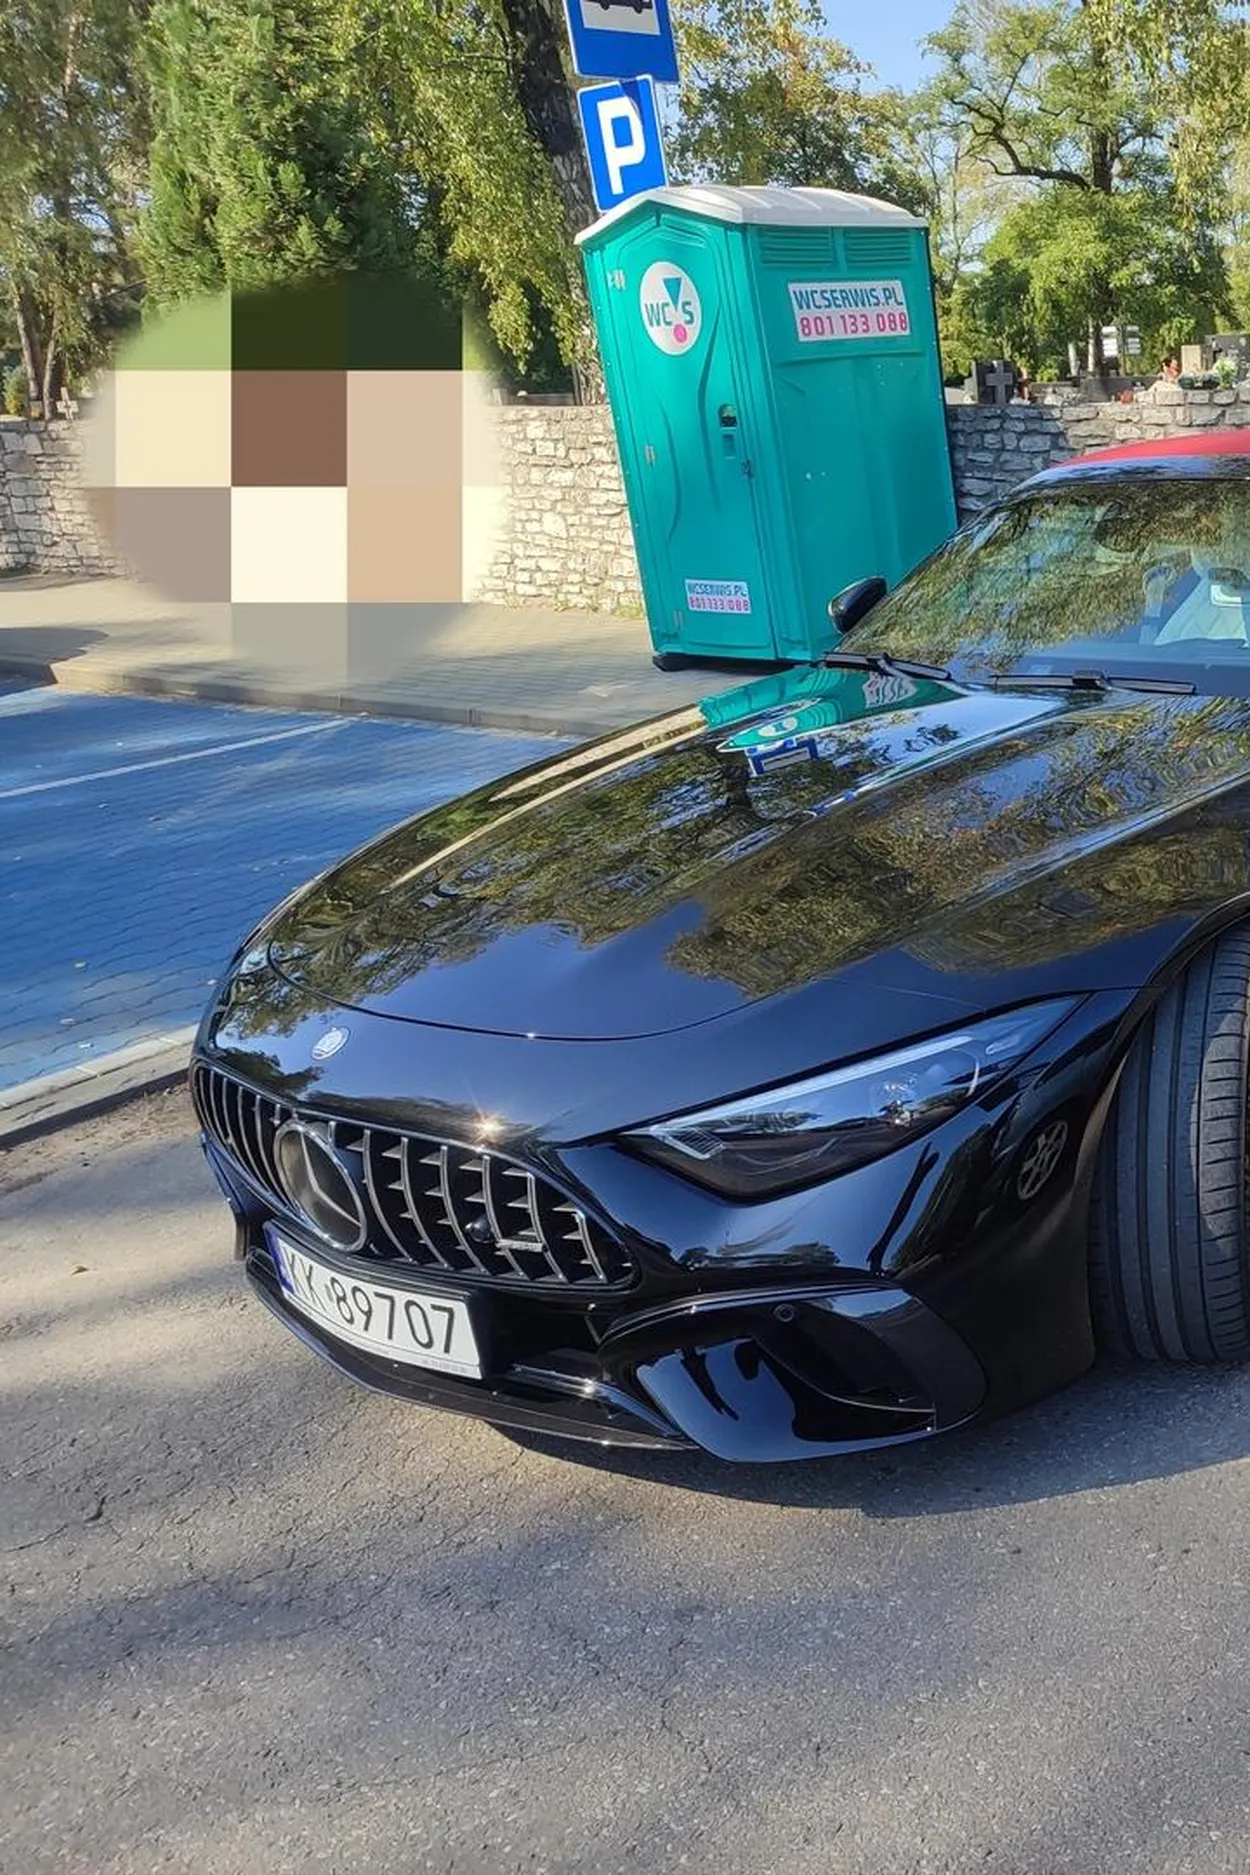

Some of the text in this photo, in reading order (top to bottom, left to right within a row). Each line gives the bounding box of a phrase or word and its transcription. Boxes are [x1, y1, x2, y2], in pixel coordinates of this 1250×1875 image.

[597, 96, 646, 195] P
[793, 286, 904, 310] WCSERWIS.PL
[800, 312, 907, 337] 801 133 088
[330, 1276, 456, 1354] 89707
